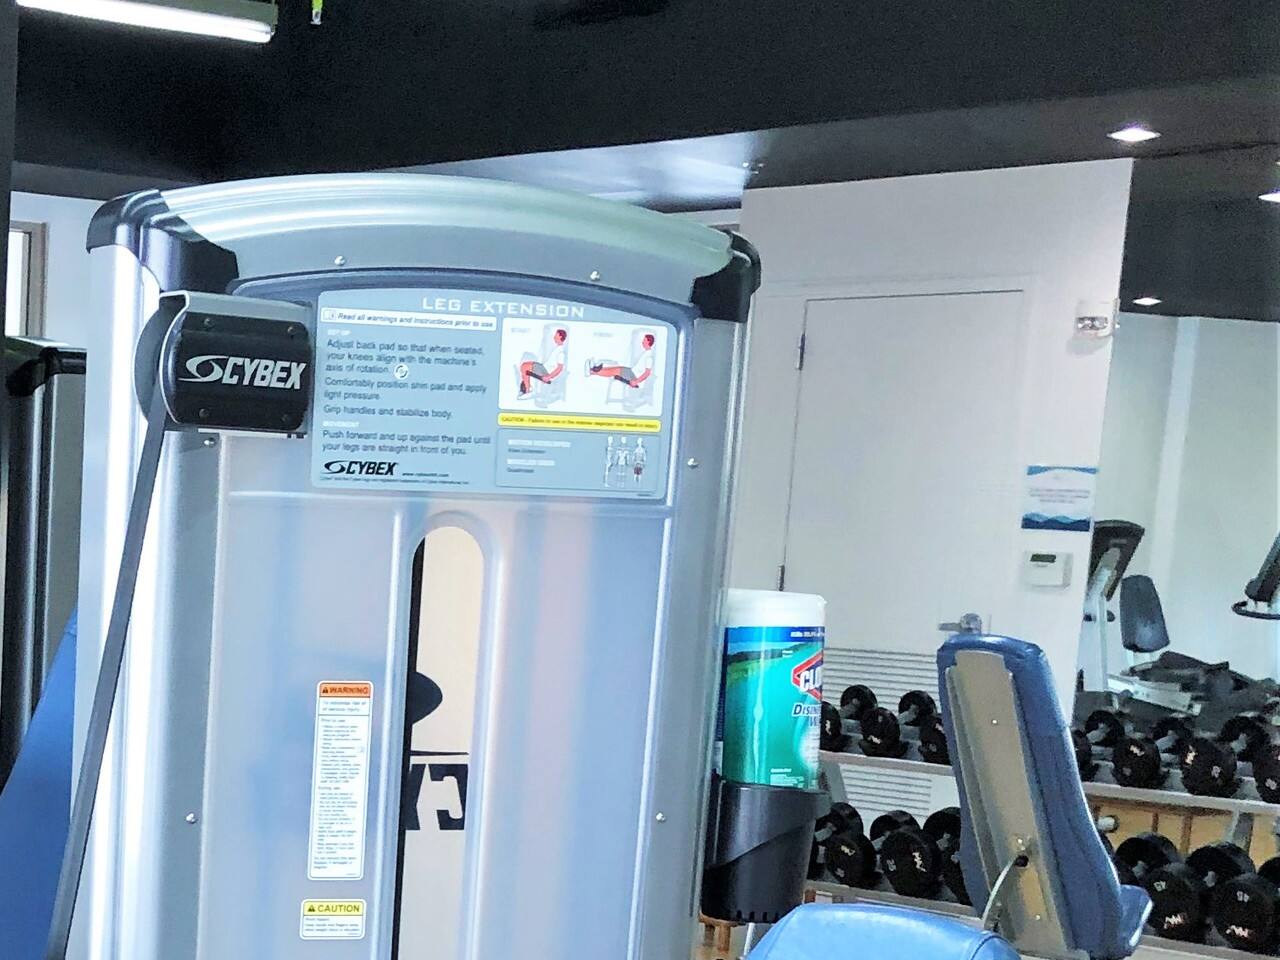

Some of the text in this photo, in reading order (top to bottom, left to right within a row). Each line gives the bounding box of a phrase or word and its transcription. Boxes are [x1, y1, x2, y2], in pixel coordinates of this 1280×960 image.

[422, 297, 584, 318] LEG EXTENSION
[367, 315, 397, 323] warnings
[414, 317, 453, 326] instructions
[455, 319, 471, 328] prior
[327, 339, 353, 350] Adjust
[356, 340, 376, 349] back
[379, 342, 395, 351] pad
[410, 343, 427, 352] that
[429, 345, 452, 353] when
[326, 352, 476, 366] your knees align with the machine's
[222, 356, 307, 390] CYBEX
[326, 364, 342, 372] axis
[346, 364, 354, 372] of
[324, 376, 375, 388] Comfortably
[376, 380, 408, 392] position
[430, 383, 446, 392] pad
[448, 383, 463, 392] and
[465, 384, 487, 394] apply
[324, 390, 342, 400] light
[324, 404, 341, 414] Grip
[344, 406, 376, 416] handles
[378, 408, 394, 416] and
[396, 408, 430, 417] stabilize
[322, 430, 491, 444] Push forward and up against the pad until
[322, 444, 340, 452] your
[344, 443, 360, 452] legs
[378, 444, 408, 454] straight
[420, 446, 438, 454] front
[440, 446, 448, 454] of
[346, 461, 398, 476] CYBEX
[330, 686, 369, 694] WARNING
[318, 904, 360, 912] CAUTION
